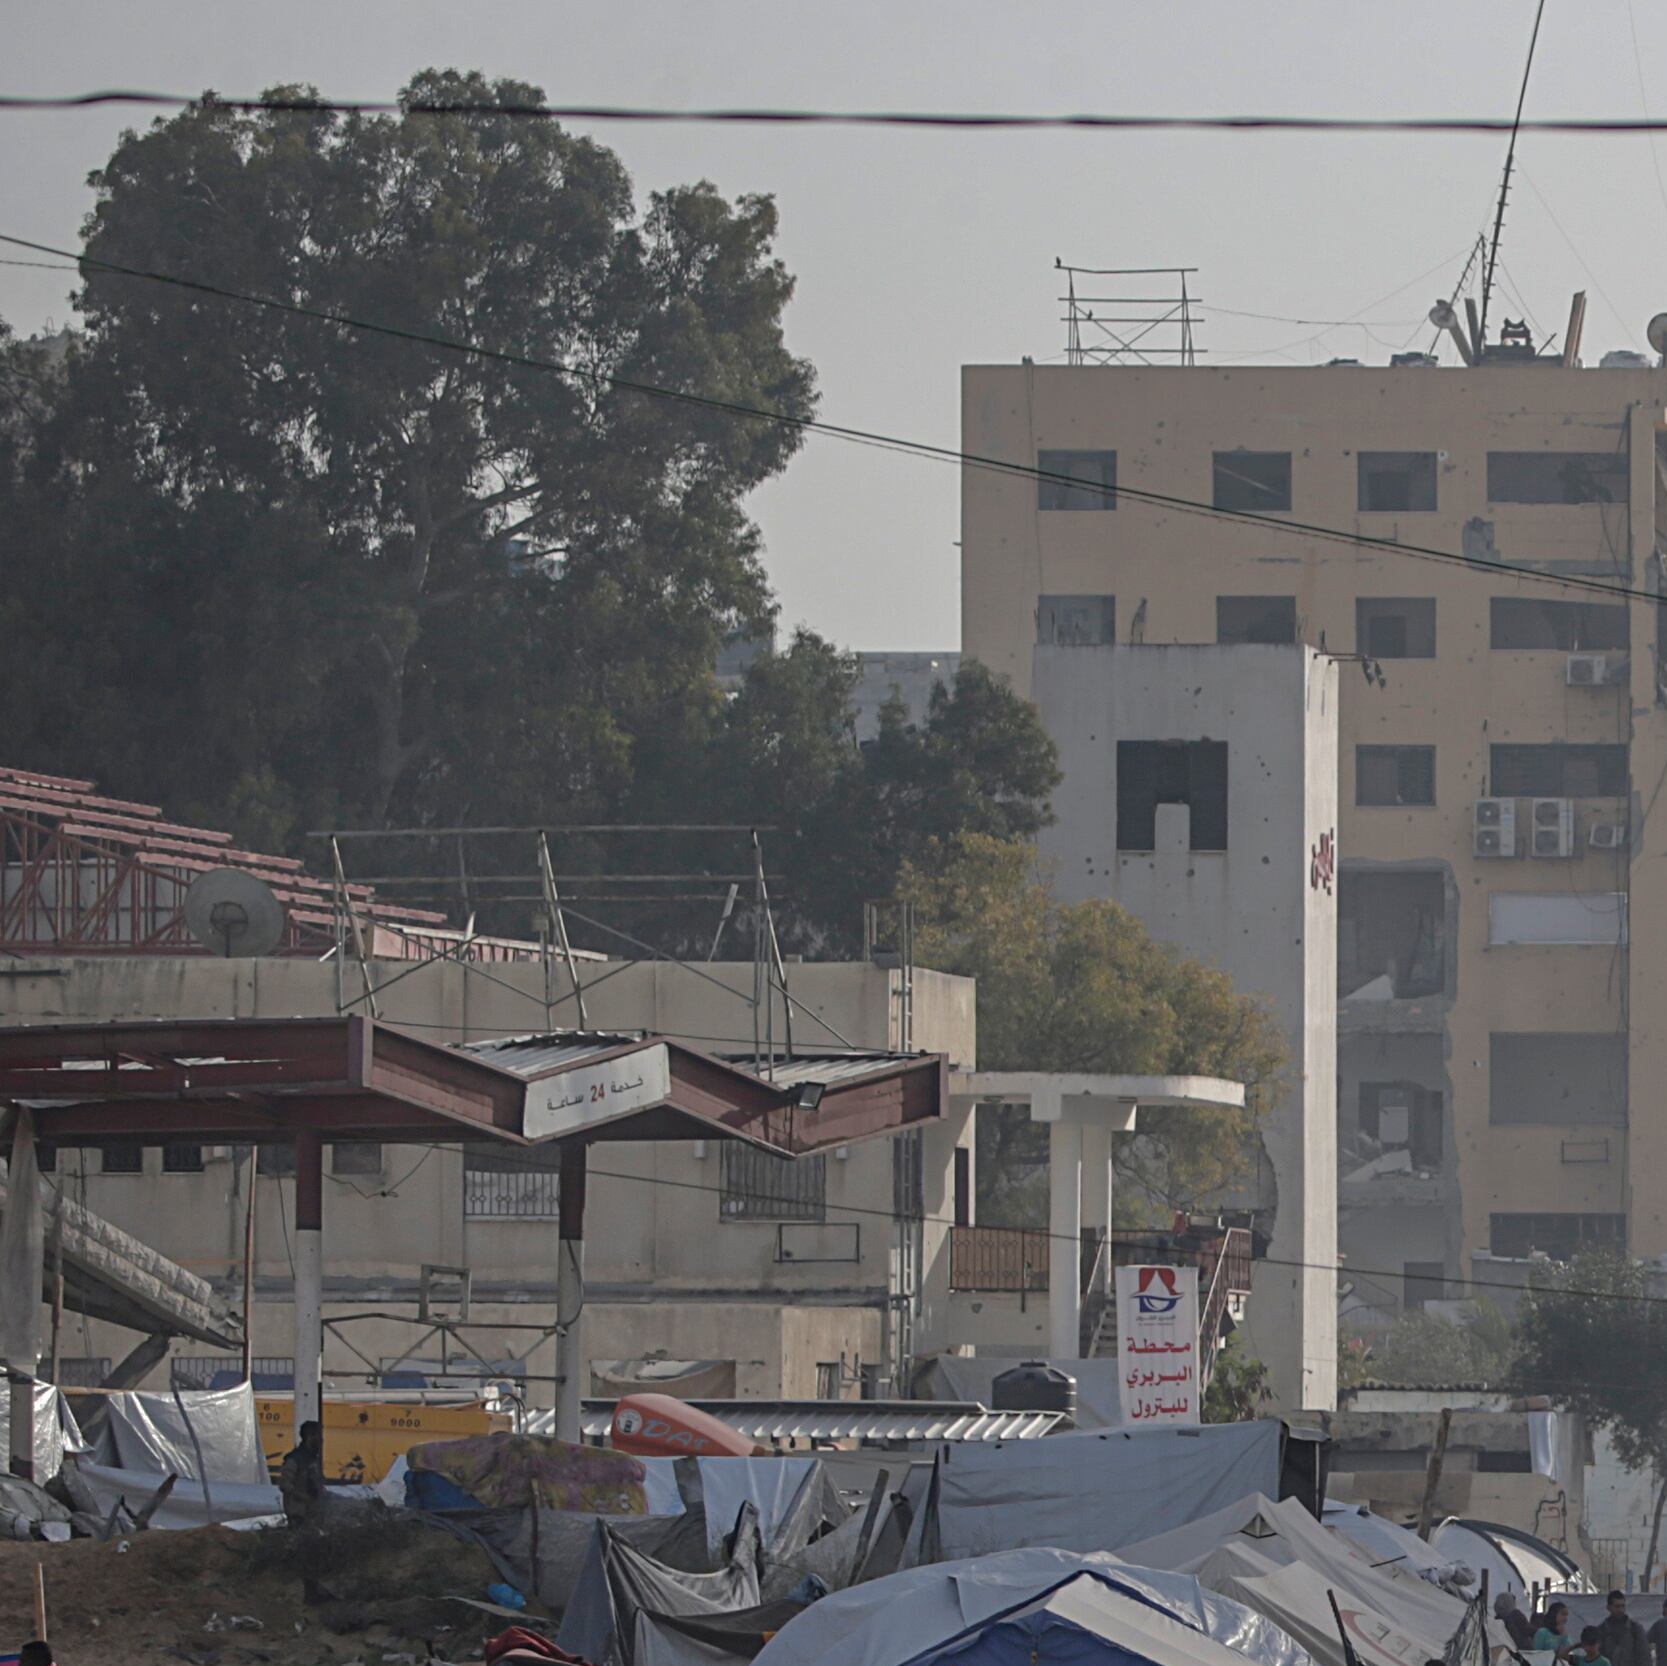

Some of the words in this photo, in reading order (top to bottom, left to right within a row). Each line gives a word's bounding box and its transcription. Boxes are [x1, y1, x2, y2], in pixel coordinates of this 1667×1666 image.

[590, 1083, 605, 1102] 24
[610, 1075, 643, 1093] خدمة
[547, 1094, 584, 1112] ساعة
[1127, 1337, 1191, 1353] محطة
[1126, 1365, 1192, 1389] البربري
[1131, 1398, 1188, 1418] للبترول
